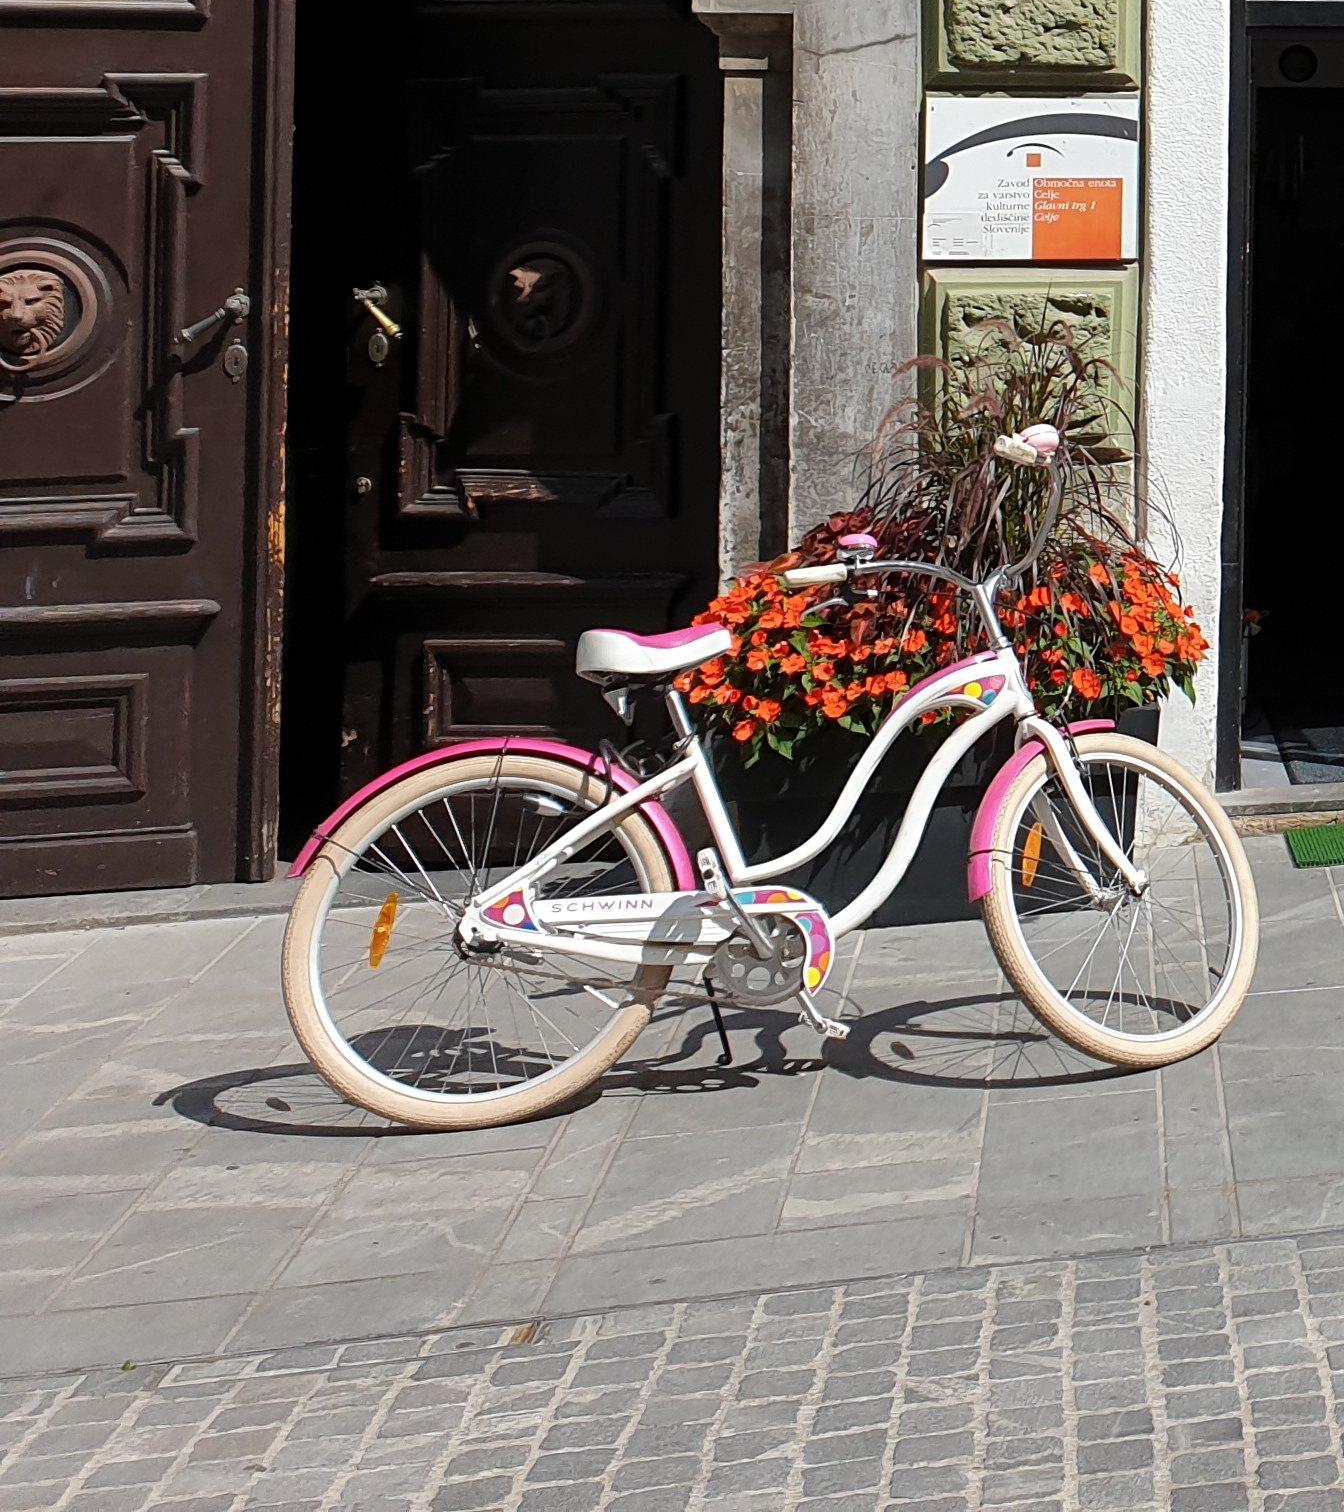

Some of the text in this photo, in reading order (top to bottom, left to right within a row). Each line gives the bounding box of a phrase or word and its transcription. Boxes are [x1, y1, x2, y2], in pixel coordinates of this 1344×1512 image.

[997, 179, 1029, 188] Zavod
[1034, 178, 1084, 187] Območna
[1034, 190, 1060, 200] Celje
[986, 202, 1029, 210] kulturne
[1034, 201, 1096, 212] Glavni trg 1
[981, 212, 1029, 222] dediščine
[1034, 213, 1060, 224] Celje
[983, 224, 1029, 234] Slovenije
[551, 899, 654, 913] SCHWINN
